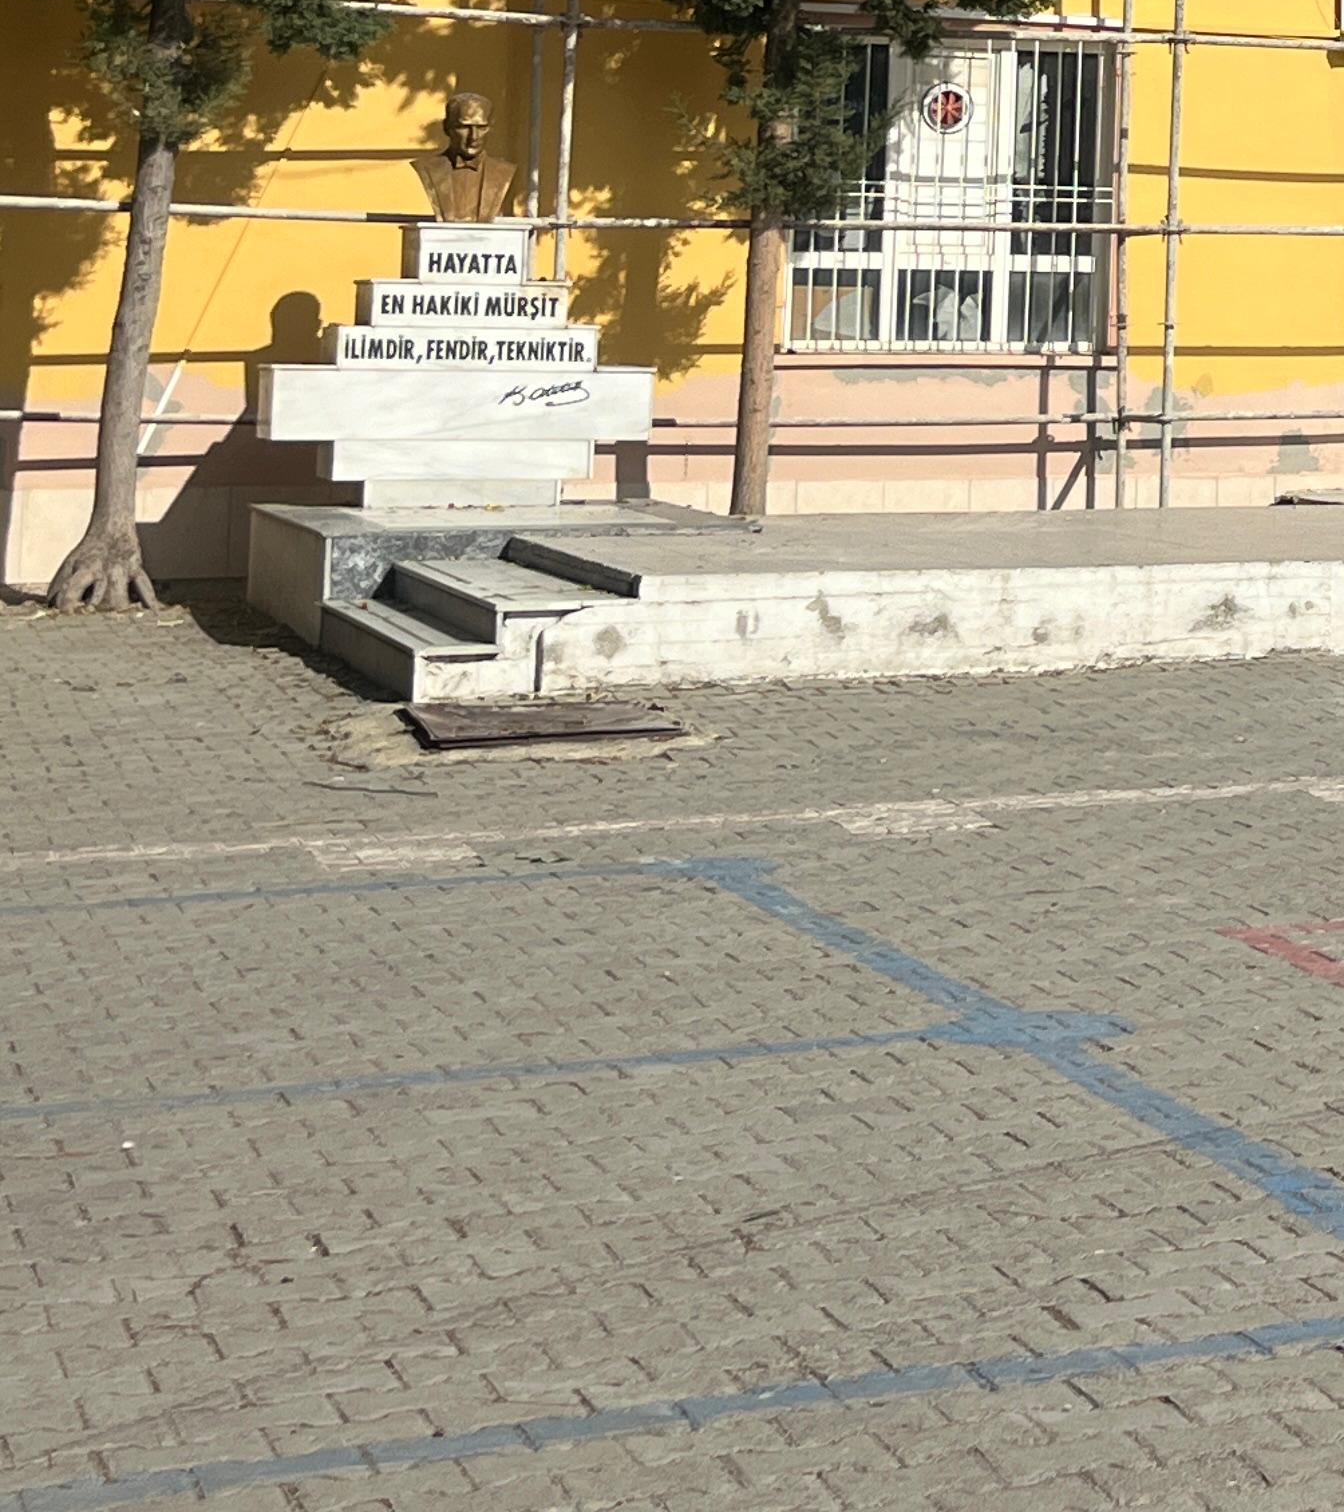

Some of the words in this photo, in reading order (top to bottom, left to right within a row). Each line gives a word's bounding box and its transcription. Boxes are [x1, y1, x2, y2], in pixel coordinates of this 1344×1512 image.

[428, 252, 518, 274] HAYATTA
[381, 294, 405, 315] EN
[412, 291, 479, 316] HAKİKİ
[484, 292, 560, 321] MÜRŞİT
[344, 334, 423, 364] İLİMDİR,
